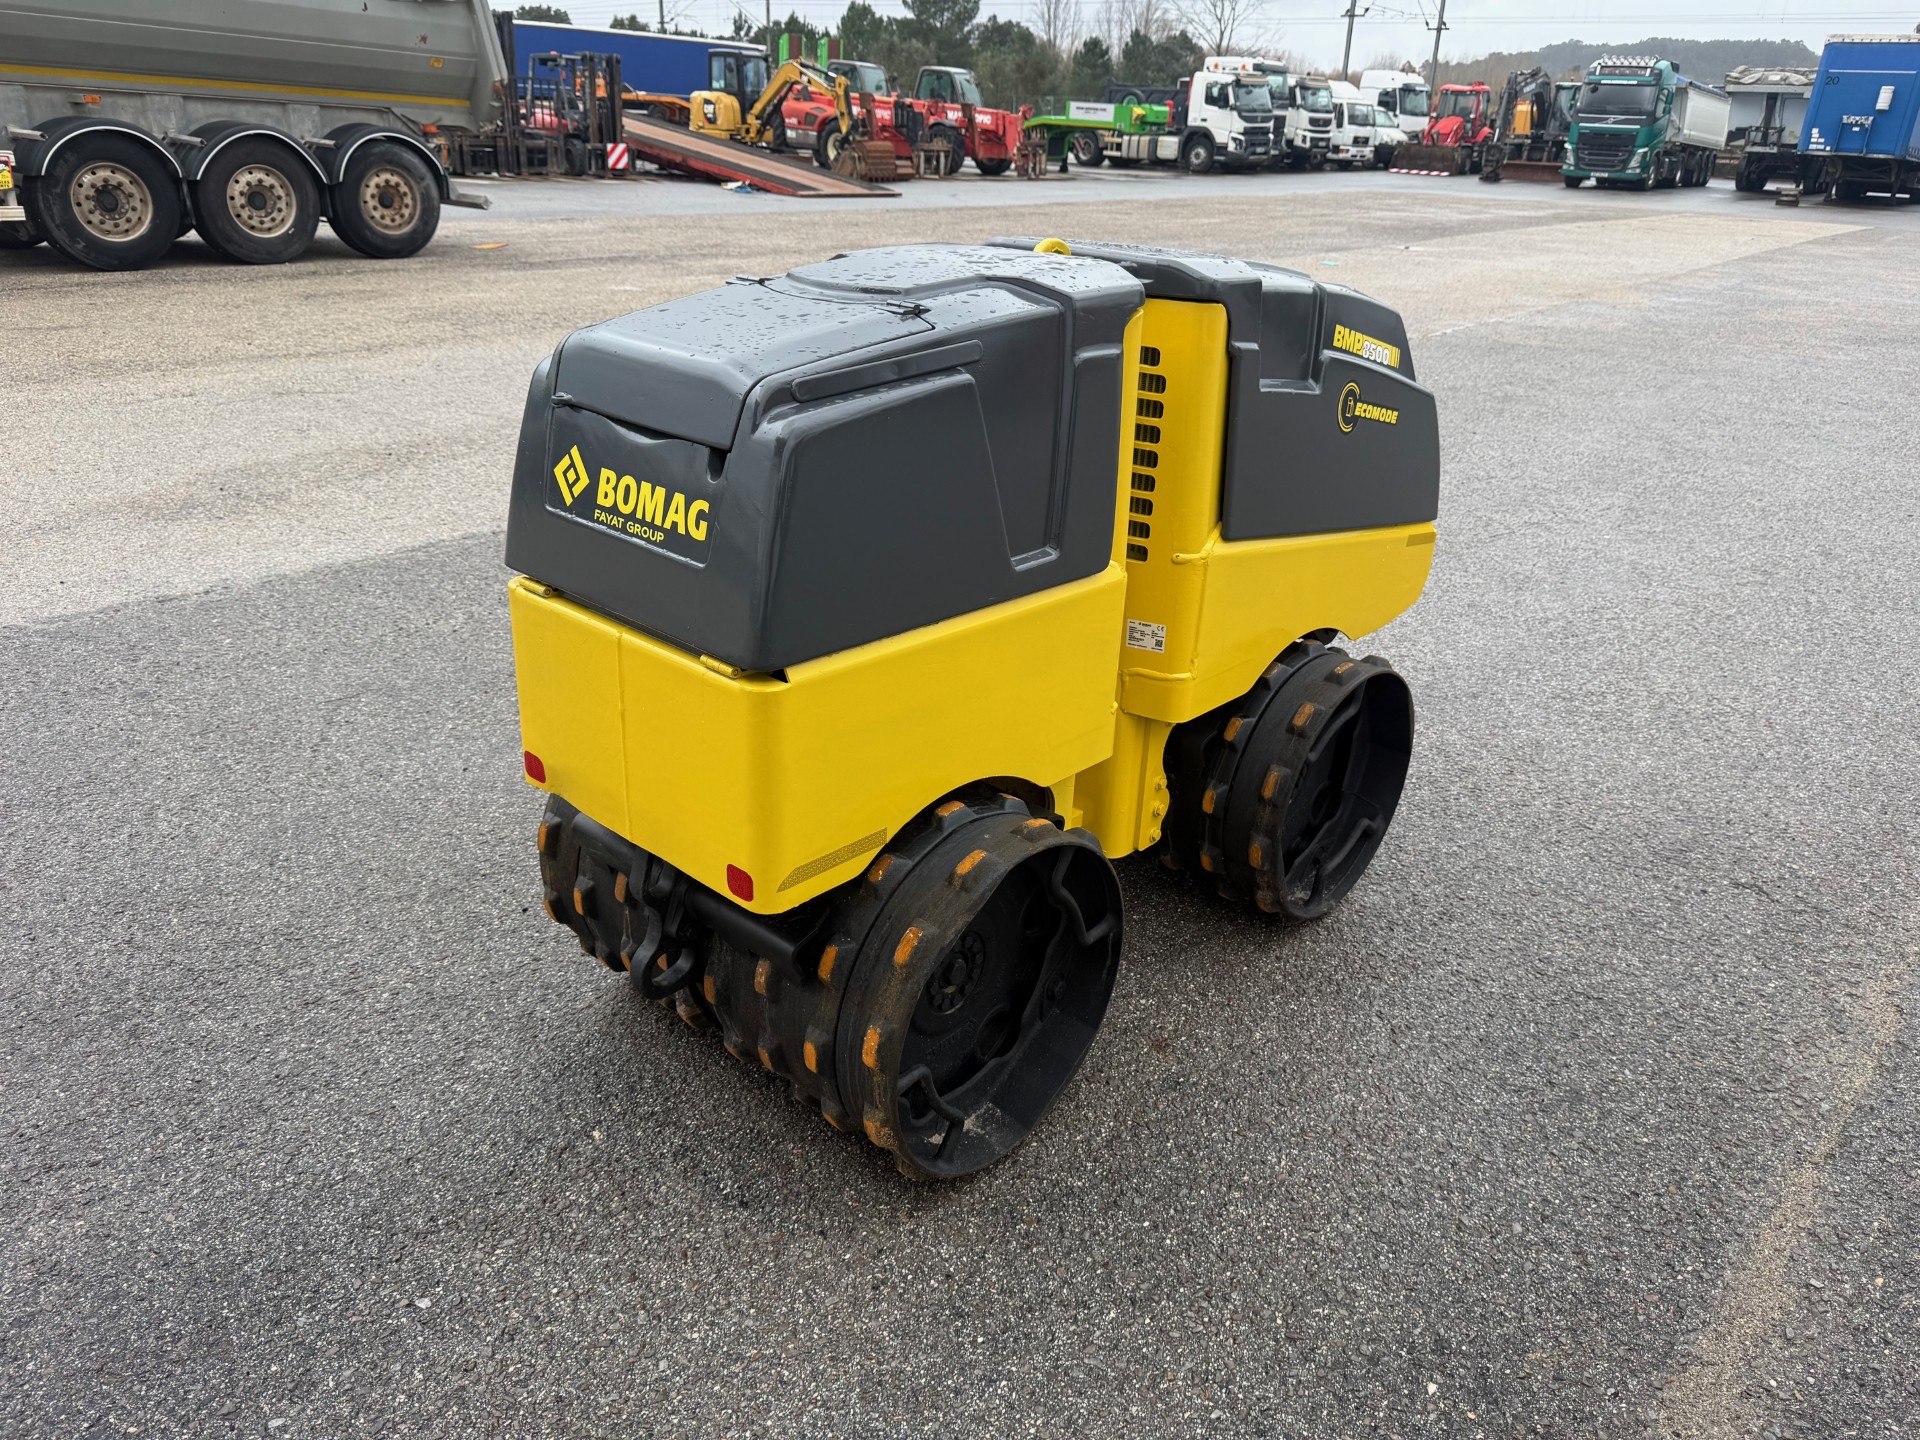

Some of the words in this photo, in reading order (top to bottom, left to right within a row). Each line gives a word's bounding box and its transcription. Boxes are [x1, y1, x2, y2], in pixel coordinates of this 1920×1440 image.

[1825, 76, 1840, 86] 20
[1354, 402, 1399, 424] ECOMODE
[596, 467, 710, 541] BOMAG
[594, 509, 624, 529] FAYAT
[626, 521, 665, 543] GROUP
